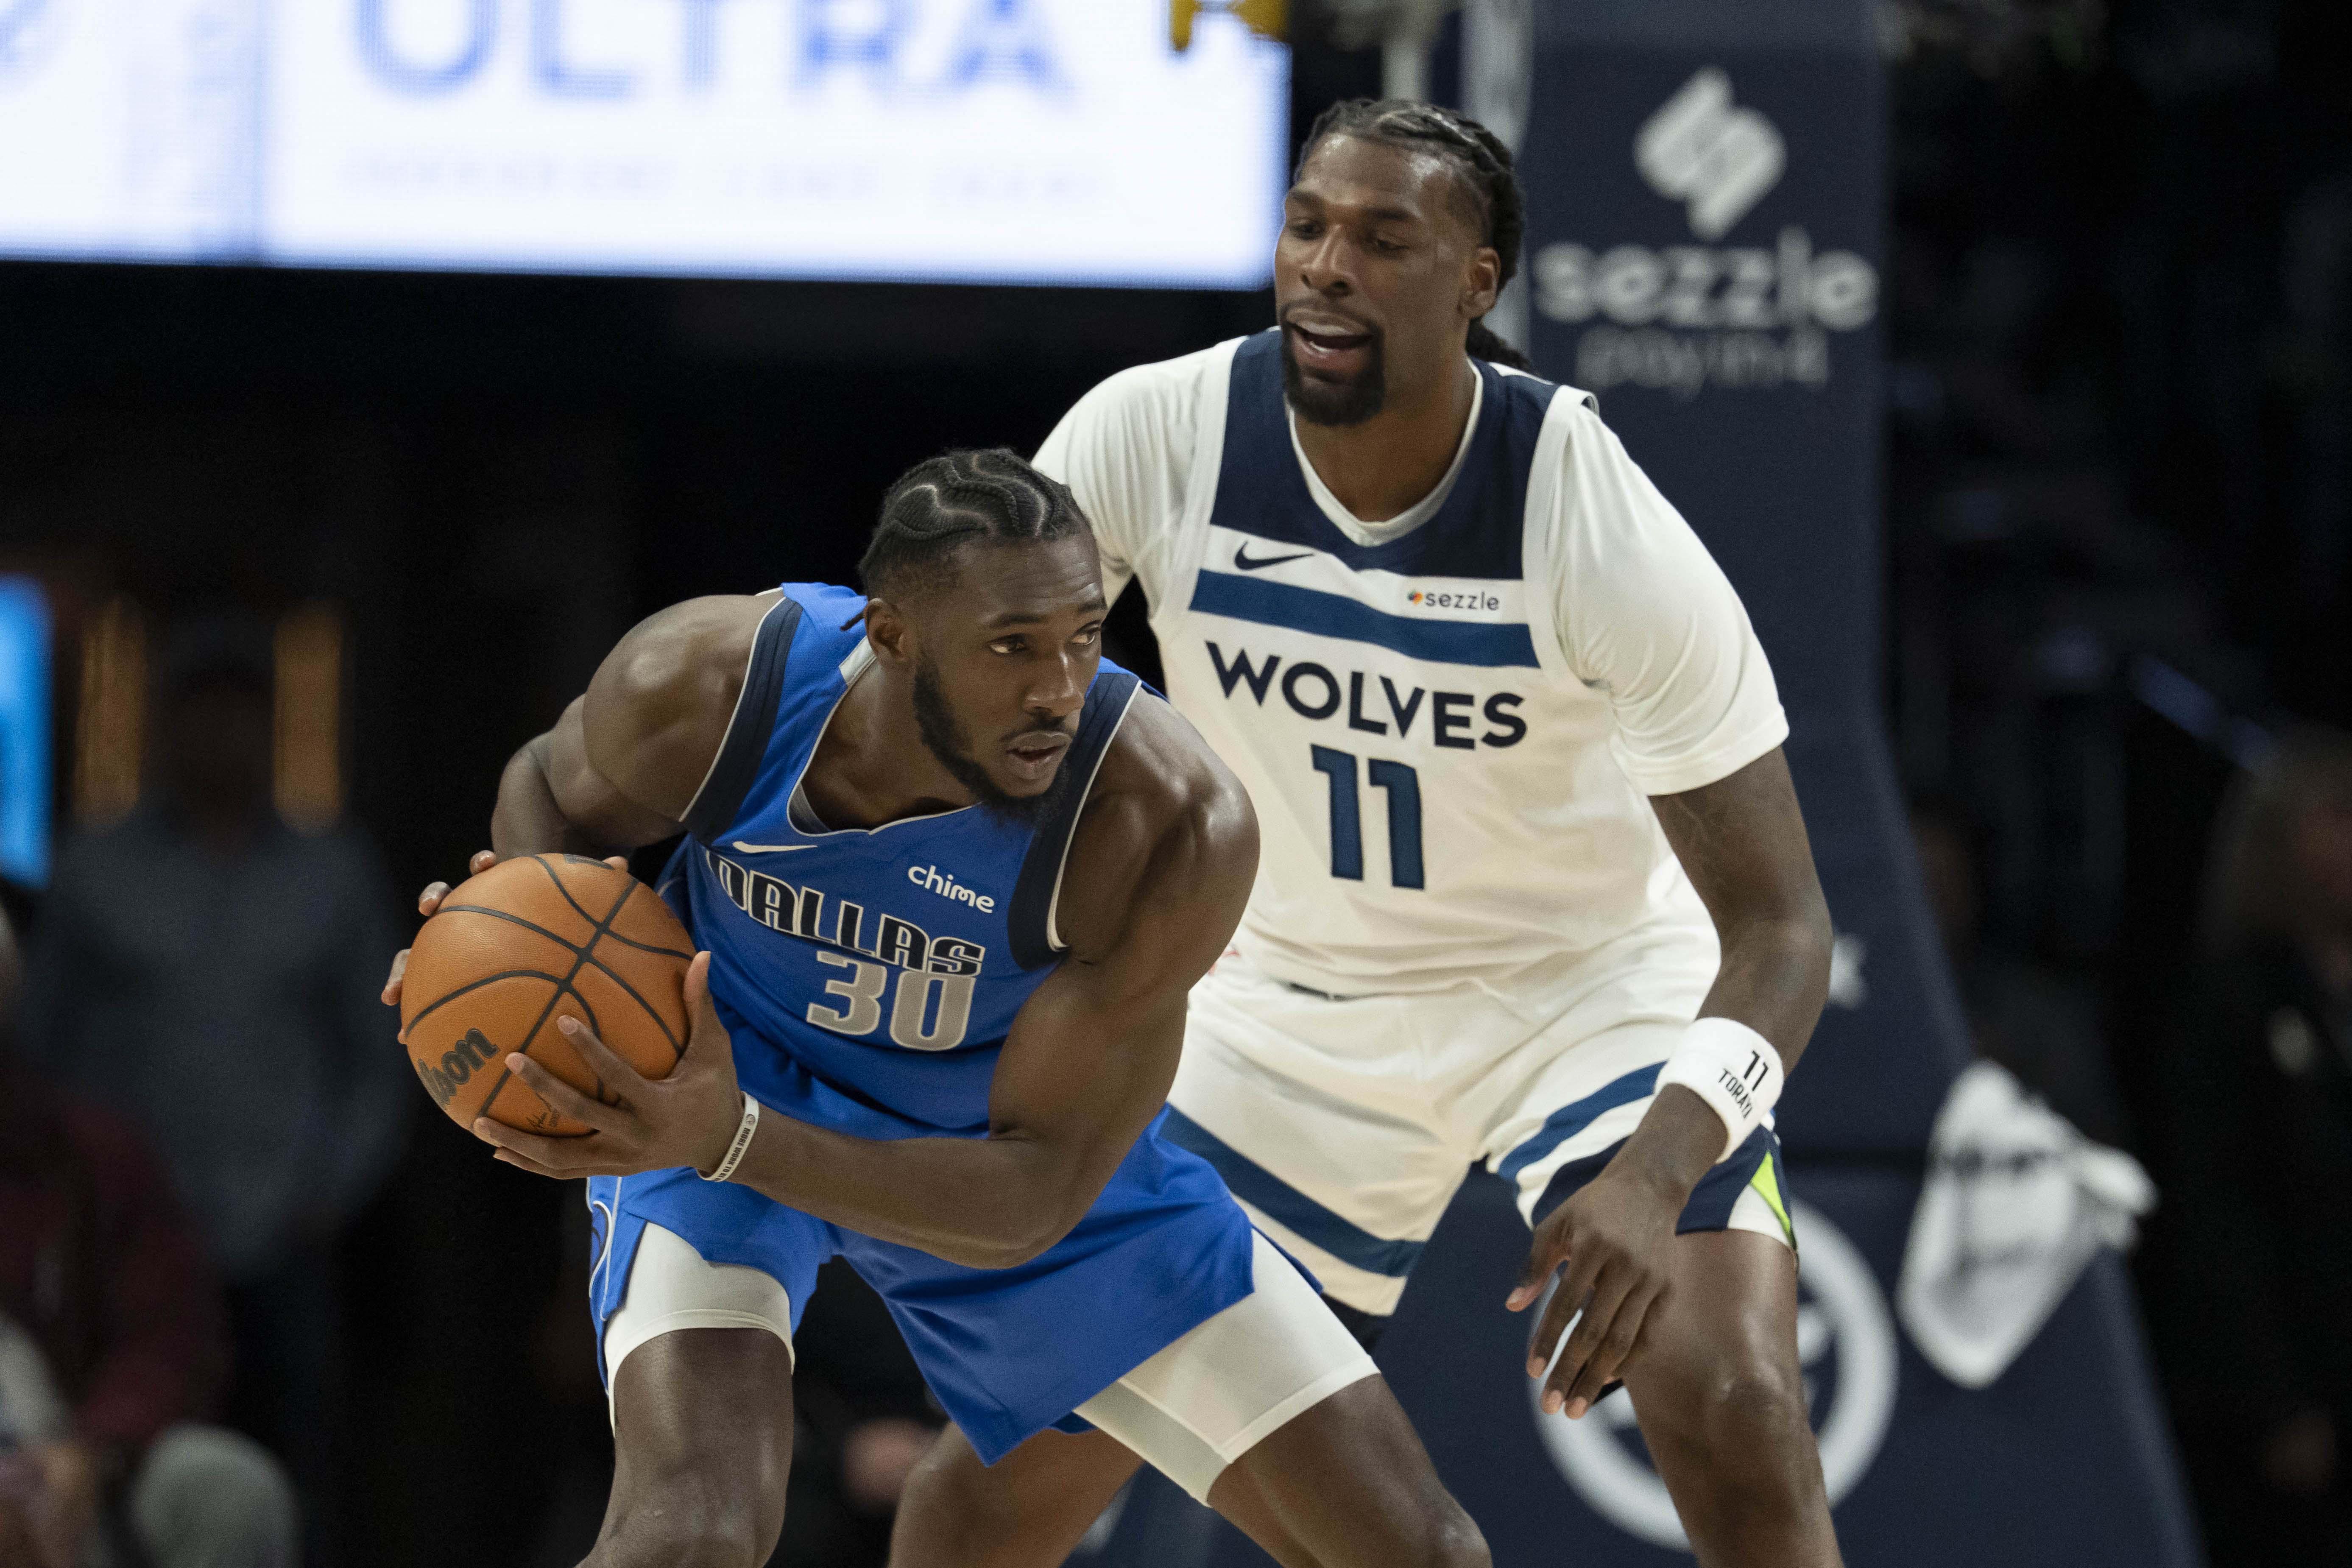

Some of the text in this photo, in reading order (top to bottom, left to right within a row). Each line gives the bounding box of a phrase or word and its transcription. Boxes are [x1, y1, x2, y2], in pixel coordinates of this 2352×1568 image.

[1532, 225, 1880, 332] sezzle
[1426, 591, 1499, 611] sezzle
[1205, 640, 1527, 750] WOLVES
[1310, 743, 1425, 890] 11
[706, 850, 986, 978] DALLAS
[907, 865, 995, 914] chime
[806, 951, 977, 1052] 30
[418, 1027, 500, 1105] lson
[1744, 1050, 1769, 1091] 11
[727, 1147, 742, 1166] WORK
[737, 1127, 751, 1147] MORE
